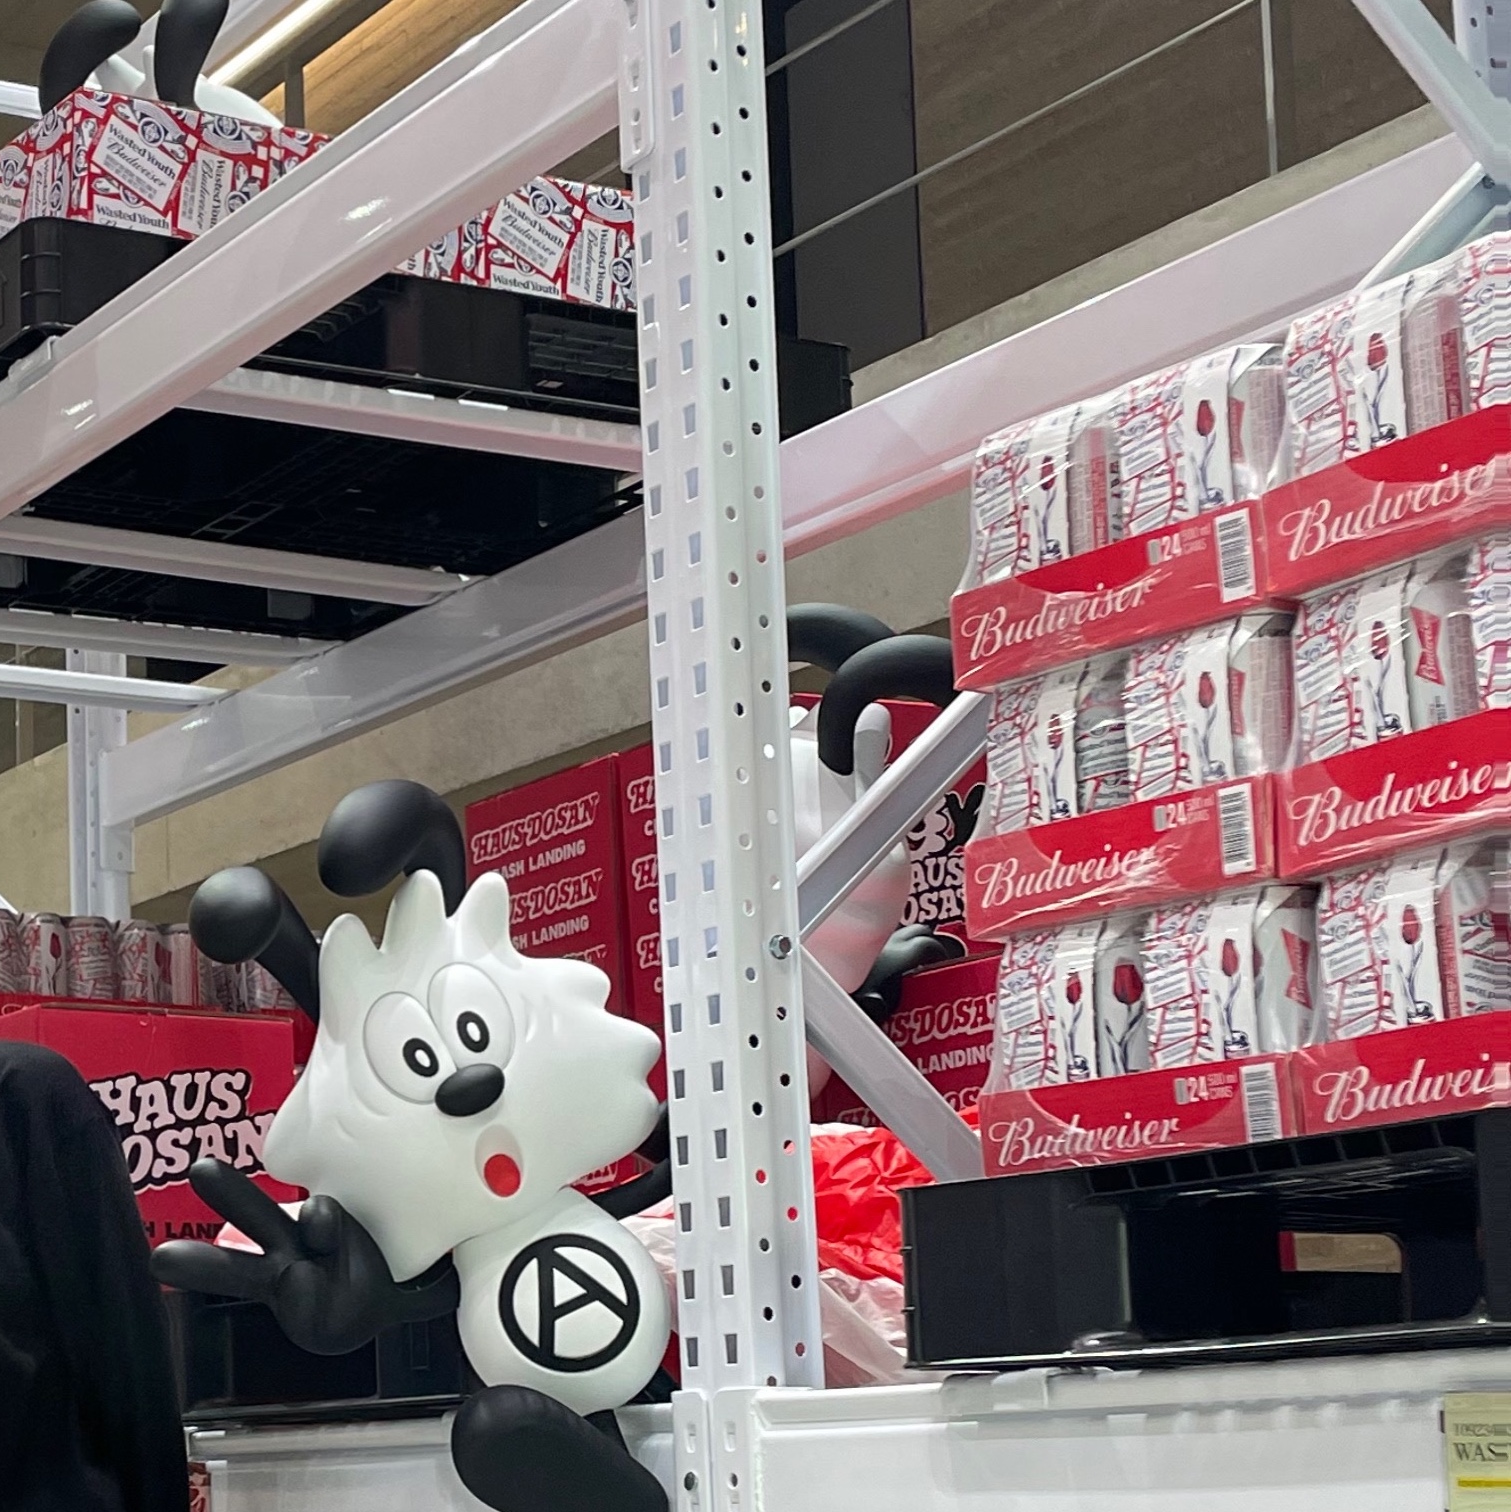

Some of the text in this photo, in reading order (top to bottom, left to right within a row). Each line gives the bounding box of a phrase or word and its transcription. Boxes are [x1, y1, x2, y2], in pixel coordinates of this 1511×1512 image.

[107, 138, 167, 188] Budweiser
[109, 124, 176, 180] Wasted Youth
[96, 204, 170, 229] Wasted Youth
[503, 199, 565, 249] Wasted Youth
[492, 272, 560, 296] Wasted Youth
[1161, 535, 1182, 561] 24
[961, 577, 1155, 661] Budweiser
[1167, 806, 1187, 830] 24
[472, 818, 525, 864] HAUS
[528, 840, 586, 872] LANDING
[910, 857, 964, 893] AUS
[976, 844, 1156, 908] Budweiser
[900, 889, 966, 926] OSA
[532, 915, 589, 946] LANDING
[90, 1071, 247, 1133] HAUS
[1190, 1077, 1208, 1102] 24
[123, 1114, 276, 1185] OSAN
[990, 1112, 1180, 1166] Budweiser
